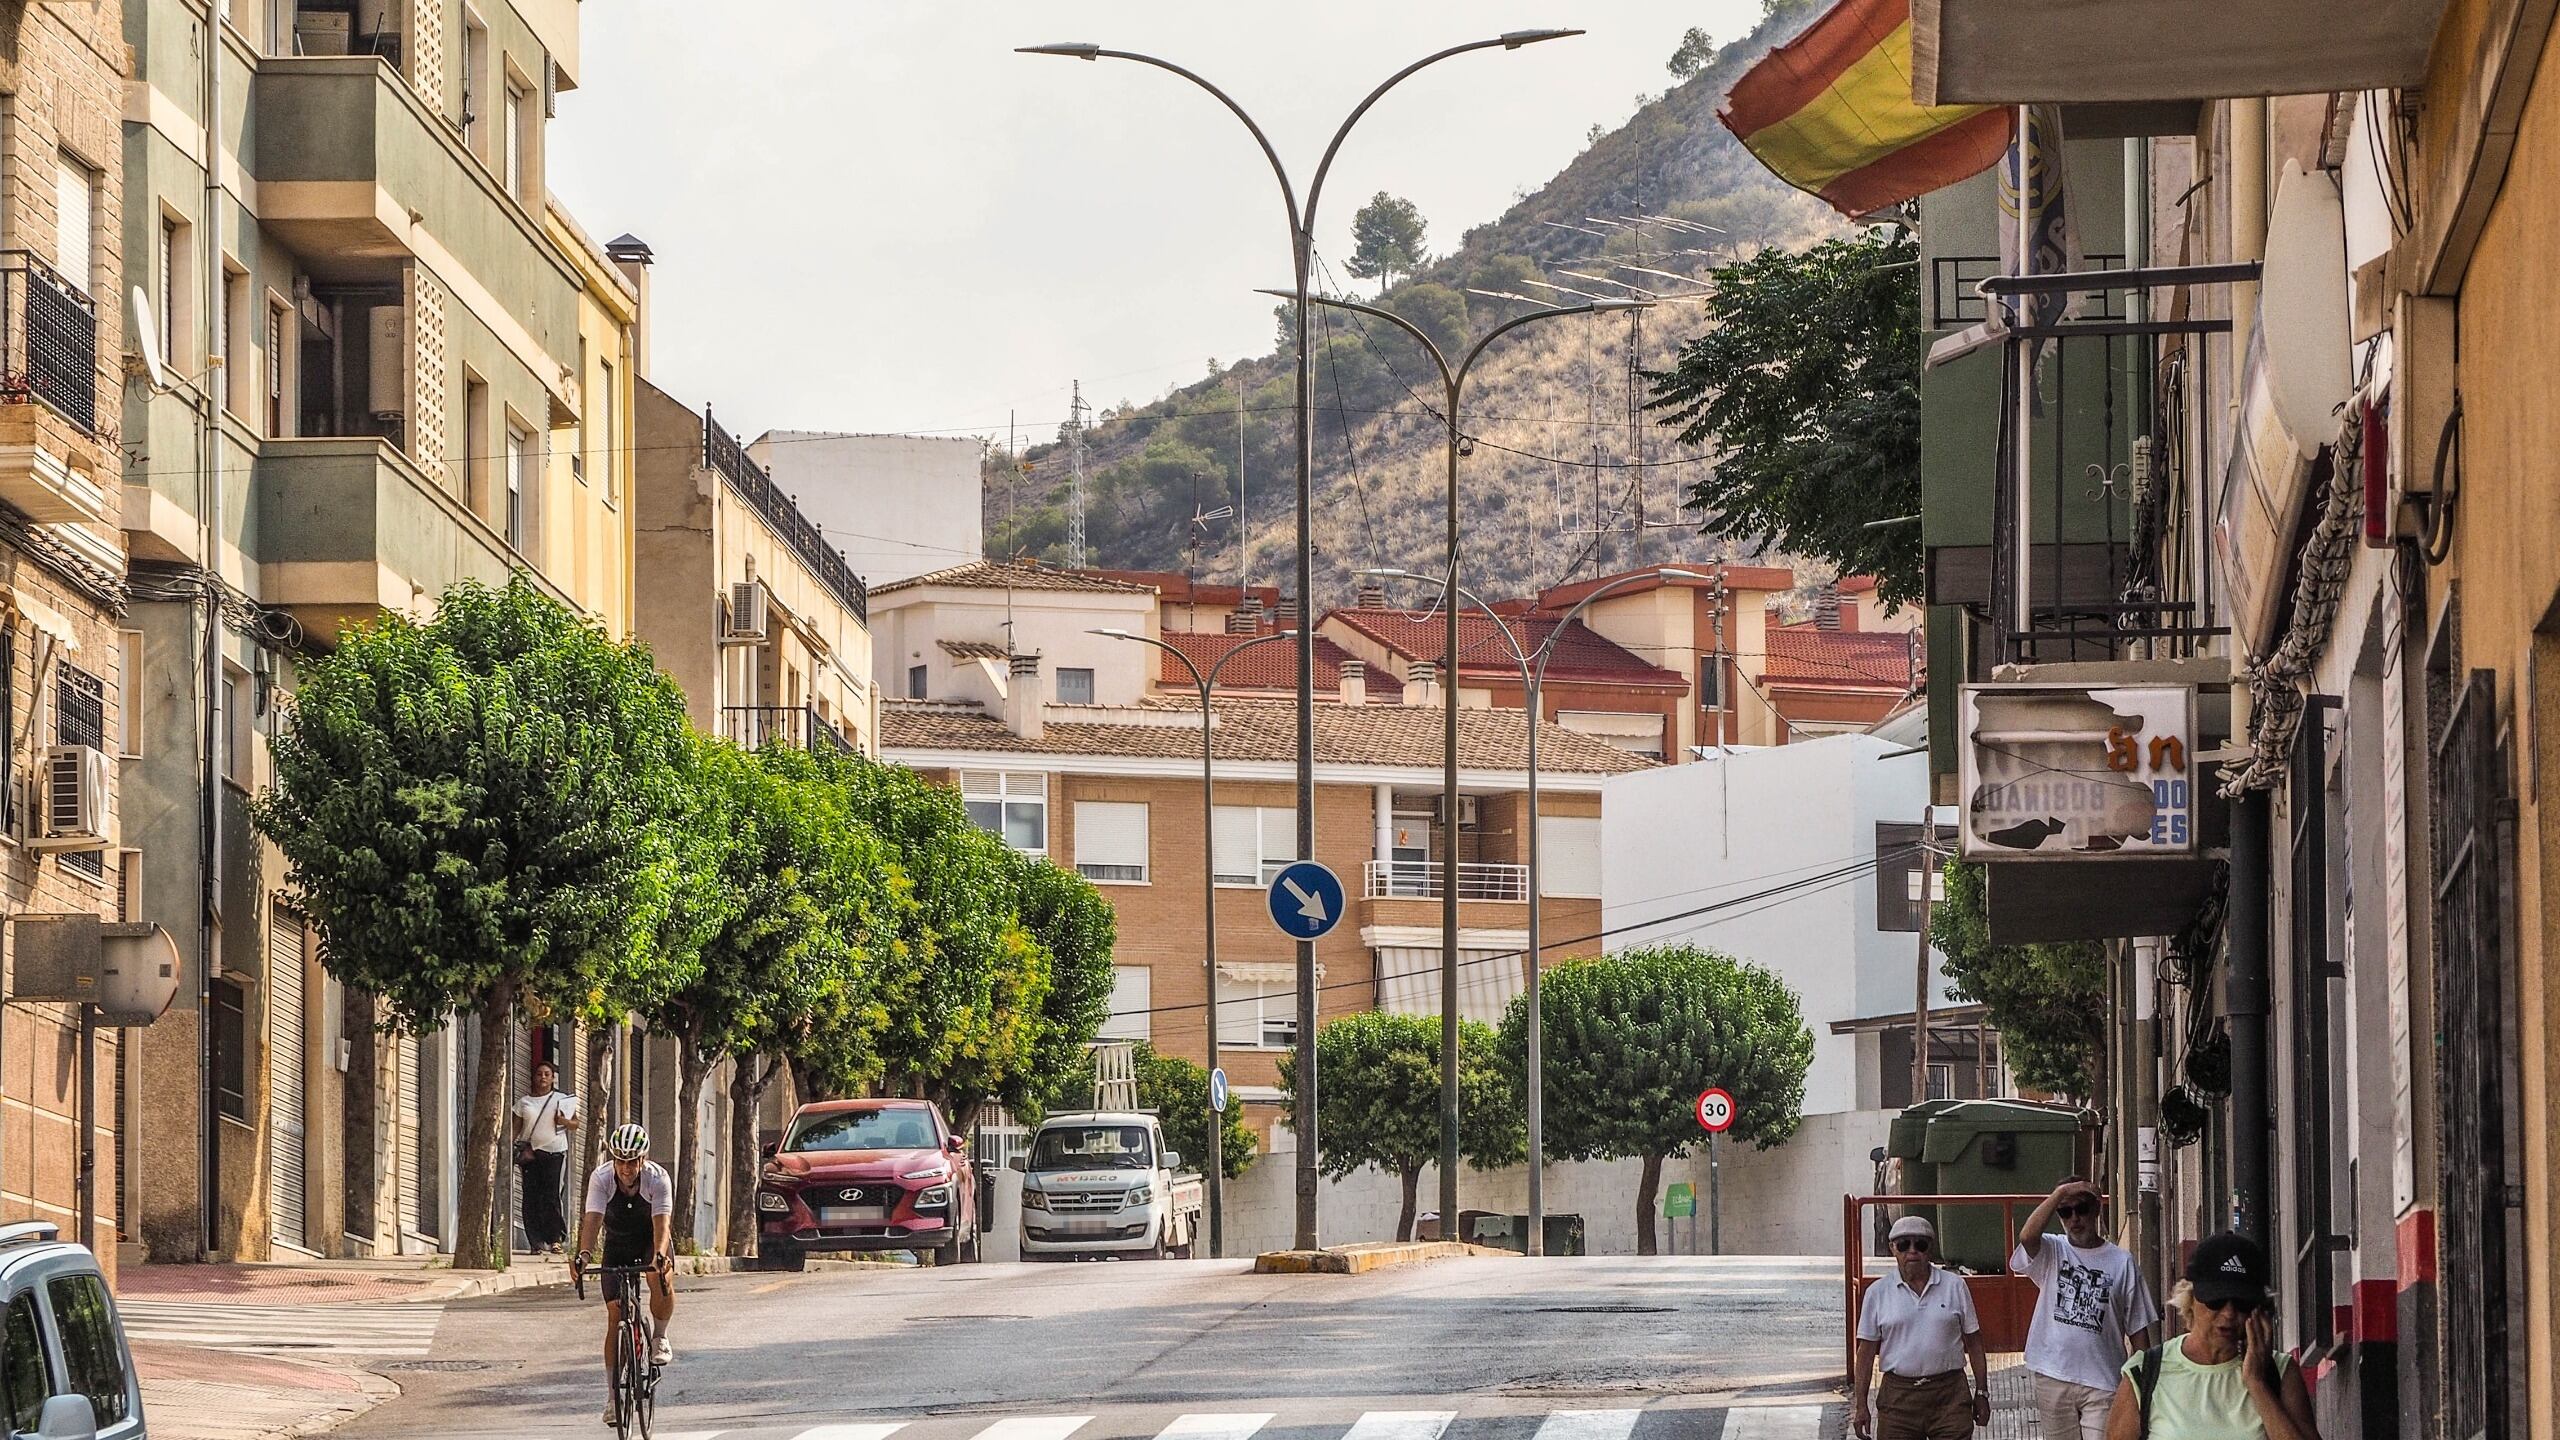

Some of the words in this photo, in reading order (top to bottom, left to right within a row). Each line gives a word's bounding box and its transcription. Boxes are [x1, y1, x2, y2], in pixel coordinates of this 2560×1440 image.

[2152, 815, 2187, 844] ES
[1705, 1103, 1726, 1117] 30
[2220, 1265, 2247, 1273] adidas
